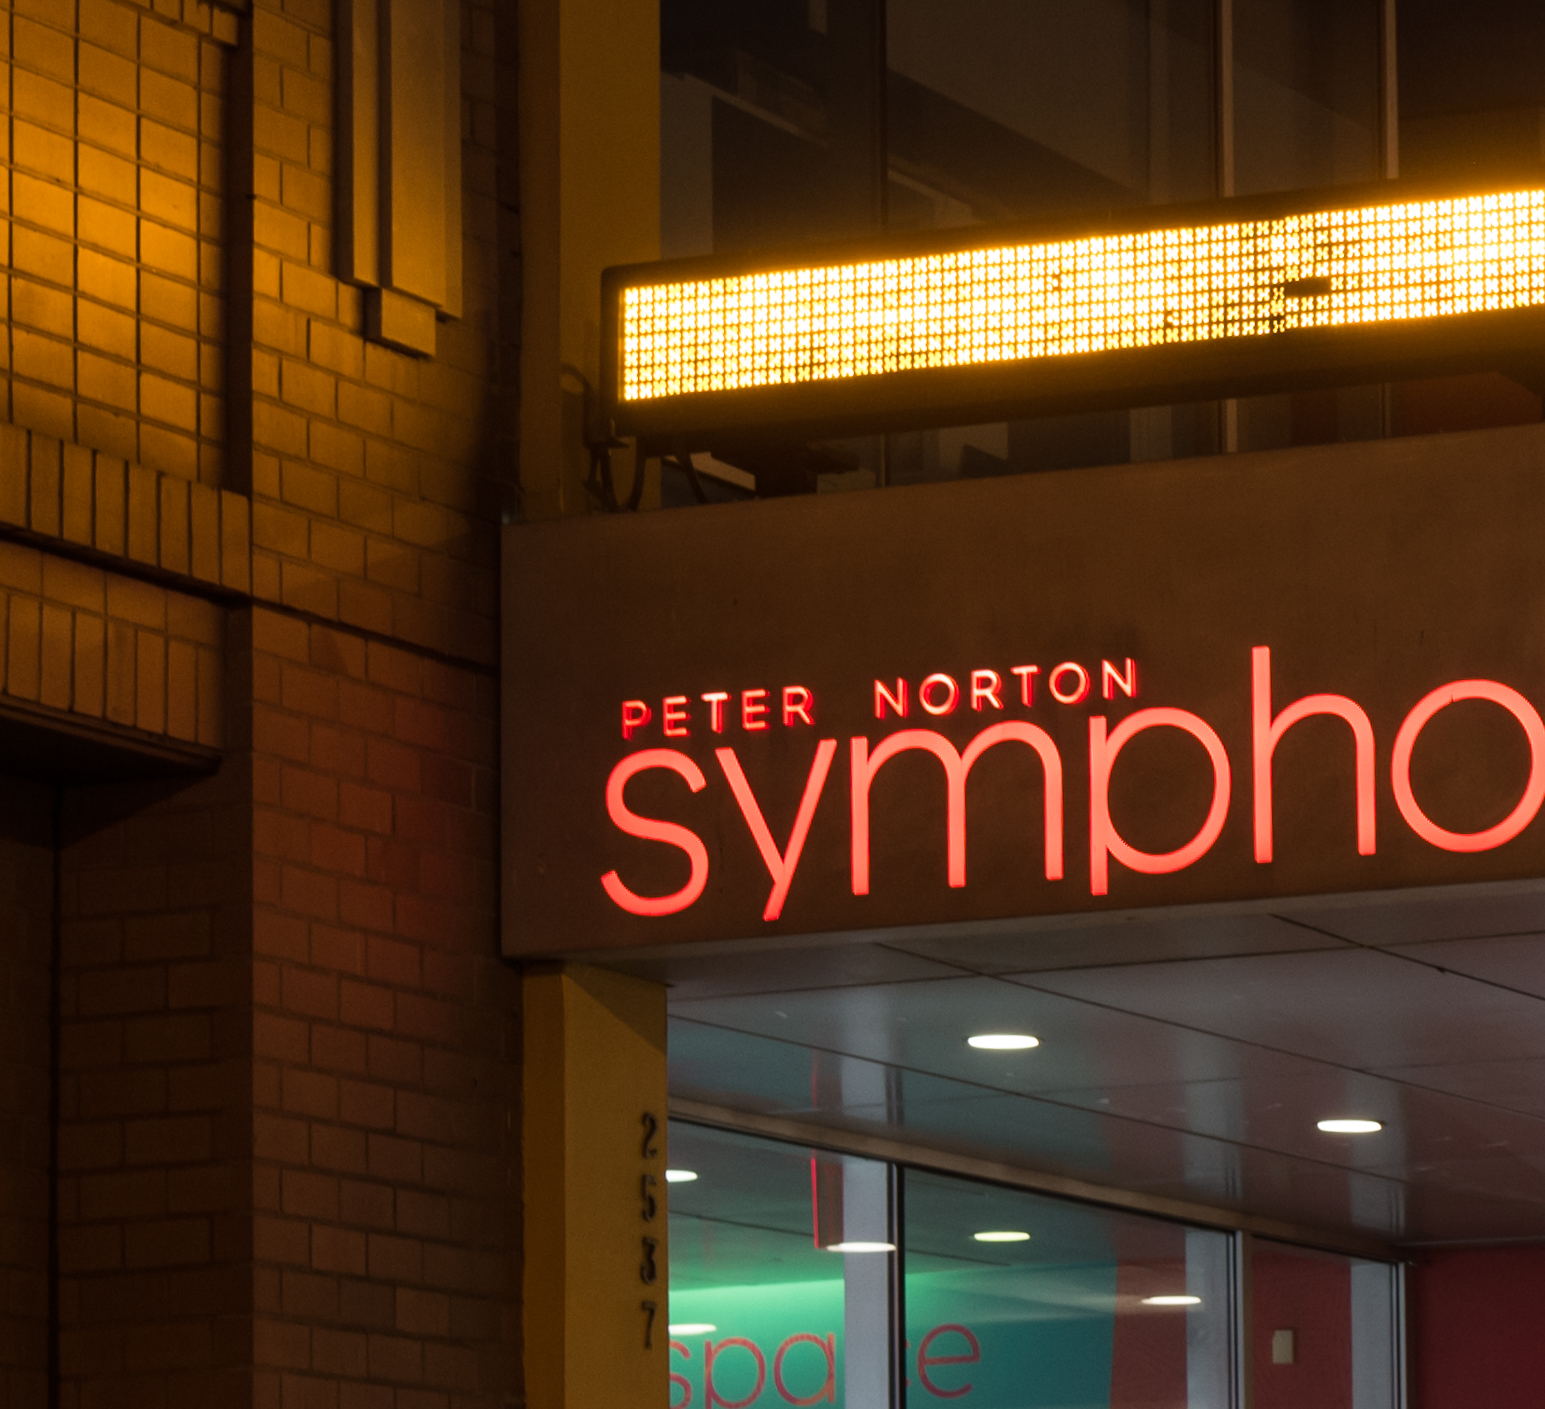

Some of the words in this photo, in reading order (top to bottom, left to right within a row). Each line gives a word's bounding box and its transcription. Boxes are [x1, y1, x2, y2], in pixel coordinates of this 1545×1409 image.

[620, 683, 816, 740] PETER
[873, 656, 1139, 720] NORTON
[638, 1111, 658, 1350] 2537
